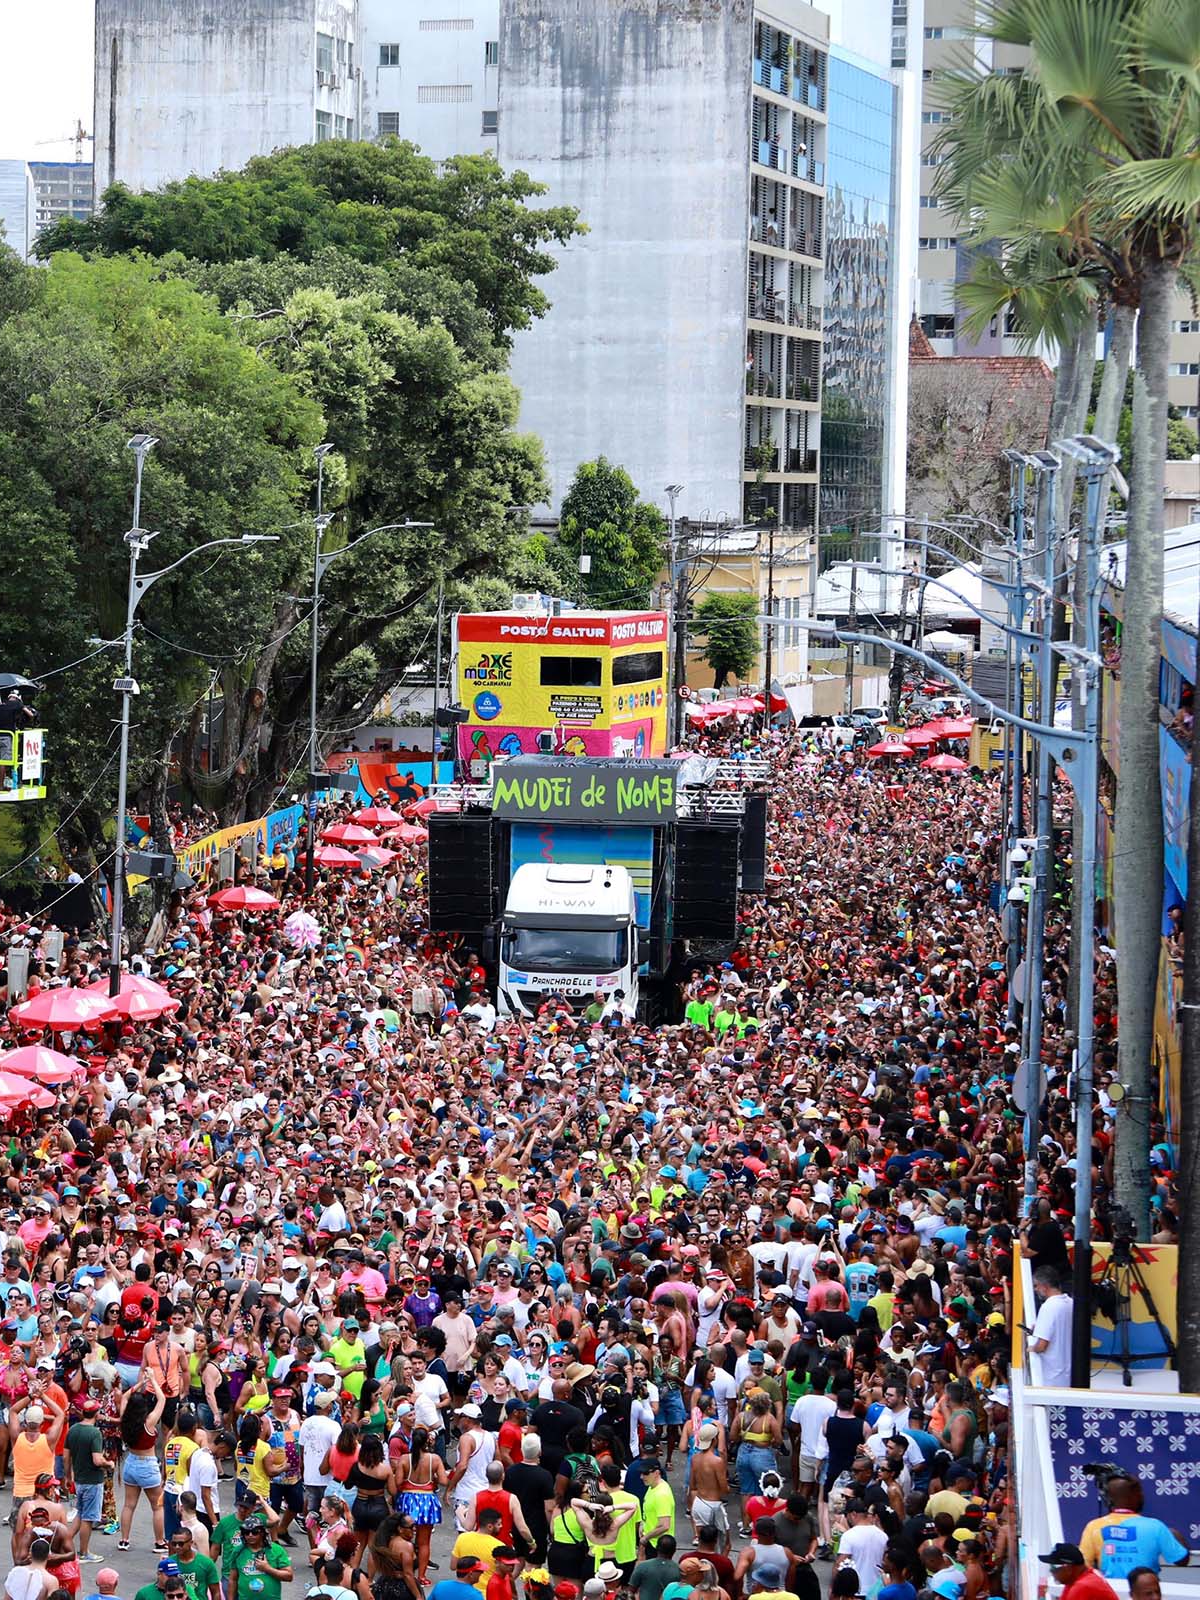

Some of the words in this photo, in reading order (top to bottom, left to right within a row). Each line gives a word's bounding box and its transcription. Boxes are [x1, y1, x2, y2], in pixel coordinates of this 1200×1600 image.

[501, 626, 548, 638] POSTO
[552, 627, 606, 638] SALTUR
[612, 624, 636, 640] POSTO
[637, 620, 664, 636] SALTUR
[478, 652, 512, 668] axé
[492, 777, 571, 812] MUDEi
[581, 775, 606, 807] de
